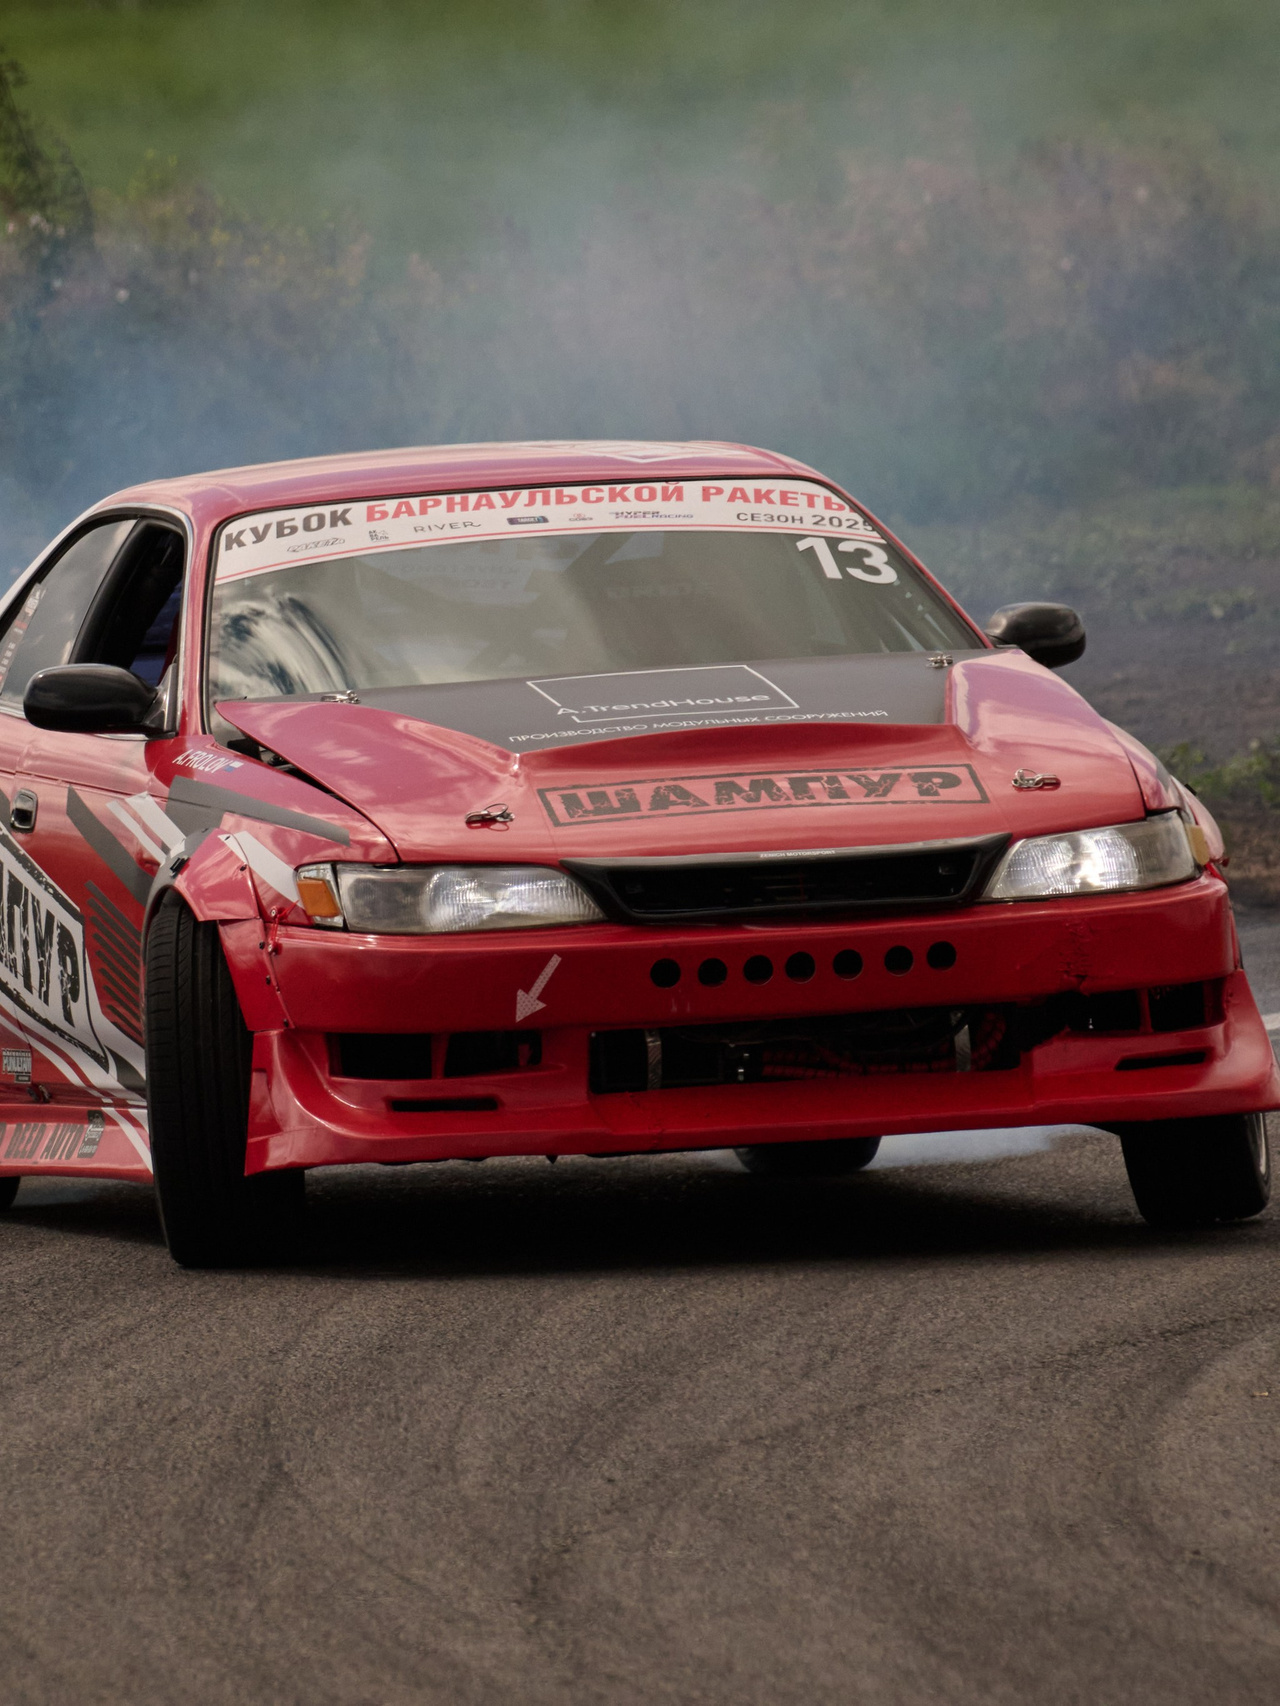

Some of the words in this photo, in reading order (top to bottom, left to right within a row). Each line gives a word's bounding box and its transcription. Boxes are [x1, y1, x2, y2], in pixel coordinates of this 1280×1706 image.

[224, 507, 353, 552] КУБОК
[365, 481, 684, 523] БАРНАУЛЬСКОЙ
[413, 521, 482, 534] RIVER
[736, 512, 805, 525] СЕЗОН
[795, 536, 898, 585] 13
[509, 724, 648, 743] ПРОИЗВОДСТВО
[653, 716, 761, 729] МОДУЛЬНЫХ
[765, 710, 889, 721] СООРУЖЕНИЙ
[559, 770, 963, 819] ШАМПУР
